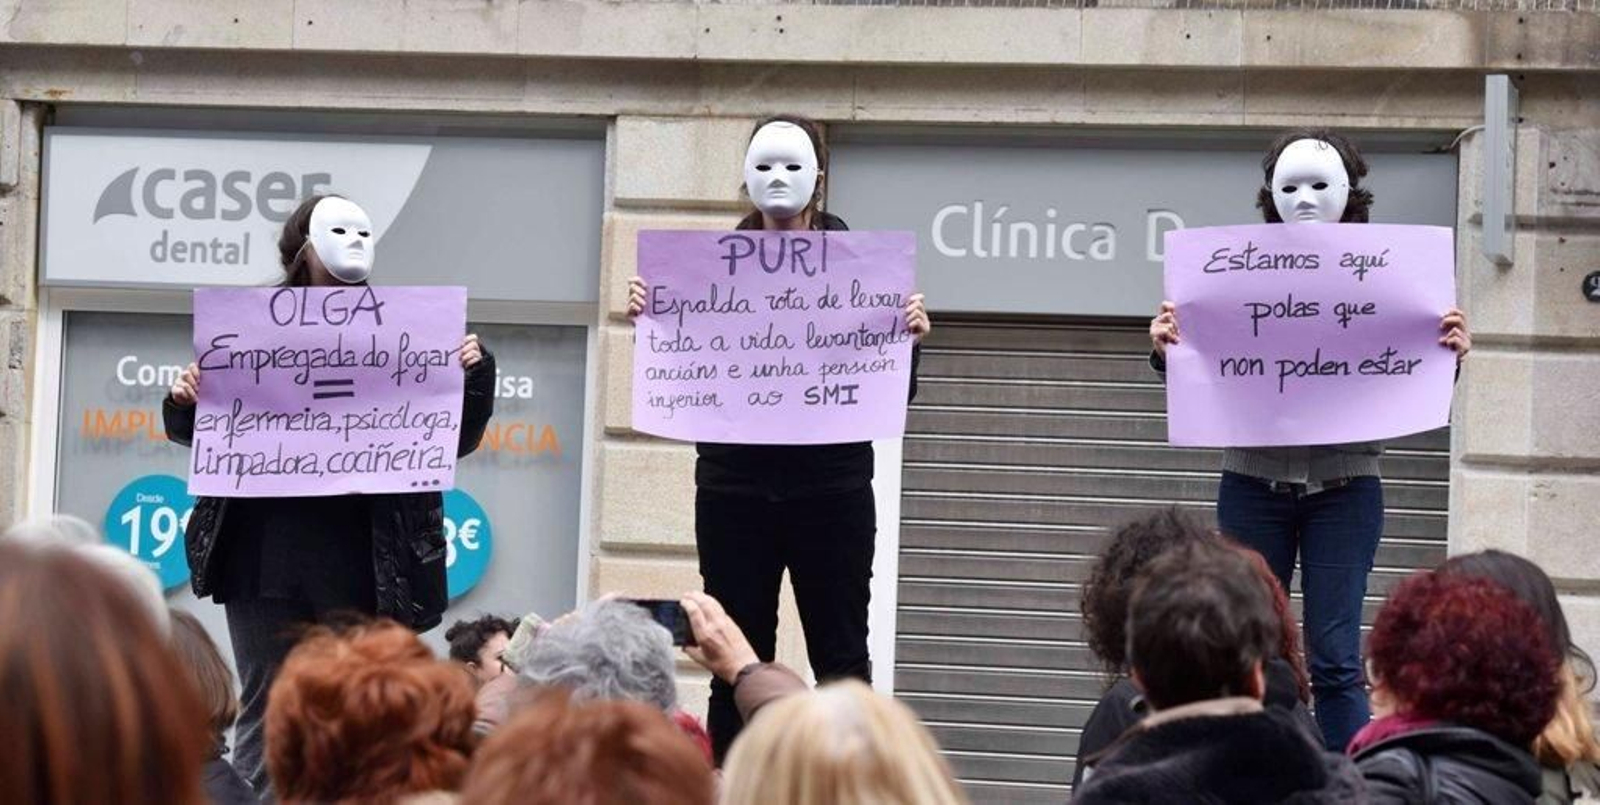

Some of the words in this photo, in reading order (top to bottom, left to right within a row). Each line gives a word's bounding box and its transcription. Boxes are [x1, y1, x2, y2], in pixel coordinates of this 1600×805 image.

[142, 168, 331, 222] caser
[150, 230, 250, 265] dental
[931, 200, 1116, 260] Clínica
[1203, 241, 1320, 273] Estamos
[1340, 249, 1390, 281] aquí
[270, 286, 385, 326] OLGA
[652, 283, 756, 328] Espalda
[765, 287, 811, 311] rota
[817, 283, 843, 310] de
[1244, 293, 1319, 337] polas
[1334, 302, 1377, 328] que
[647, 329, 702, 353] toda
[710, 335, 730, 351] a
[740, 322, 796, 349] vida
[199, 332, 358, 385] Empregada
[362, 334, 389, 368] do
[391, 331, 464, 387] fogar
[728, 364, 743, 379] e
[751, 356, 808, 378] unha
[1220, 357, 1264, 377] non
[1275, 348, 1351, 393] poden
[1358, 346, 1422, 376] estar
[747, 391, 784, 406] ao
[804, 384, 859, 405] SMI
